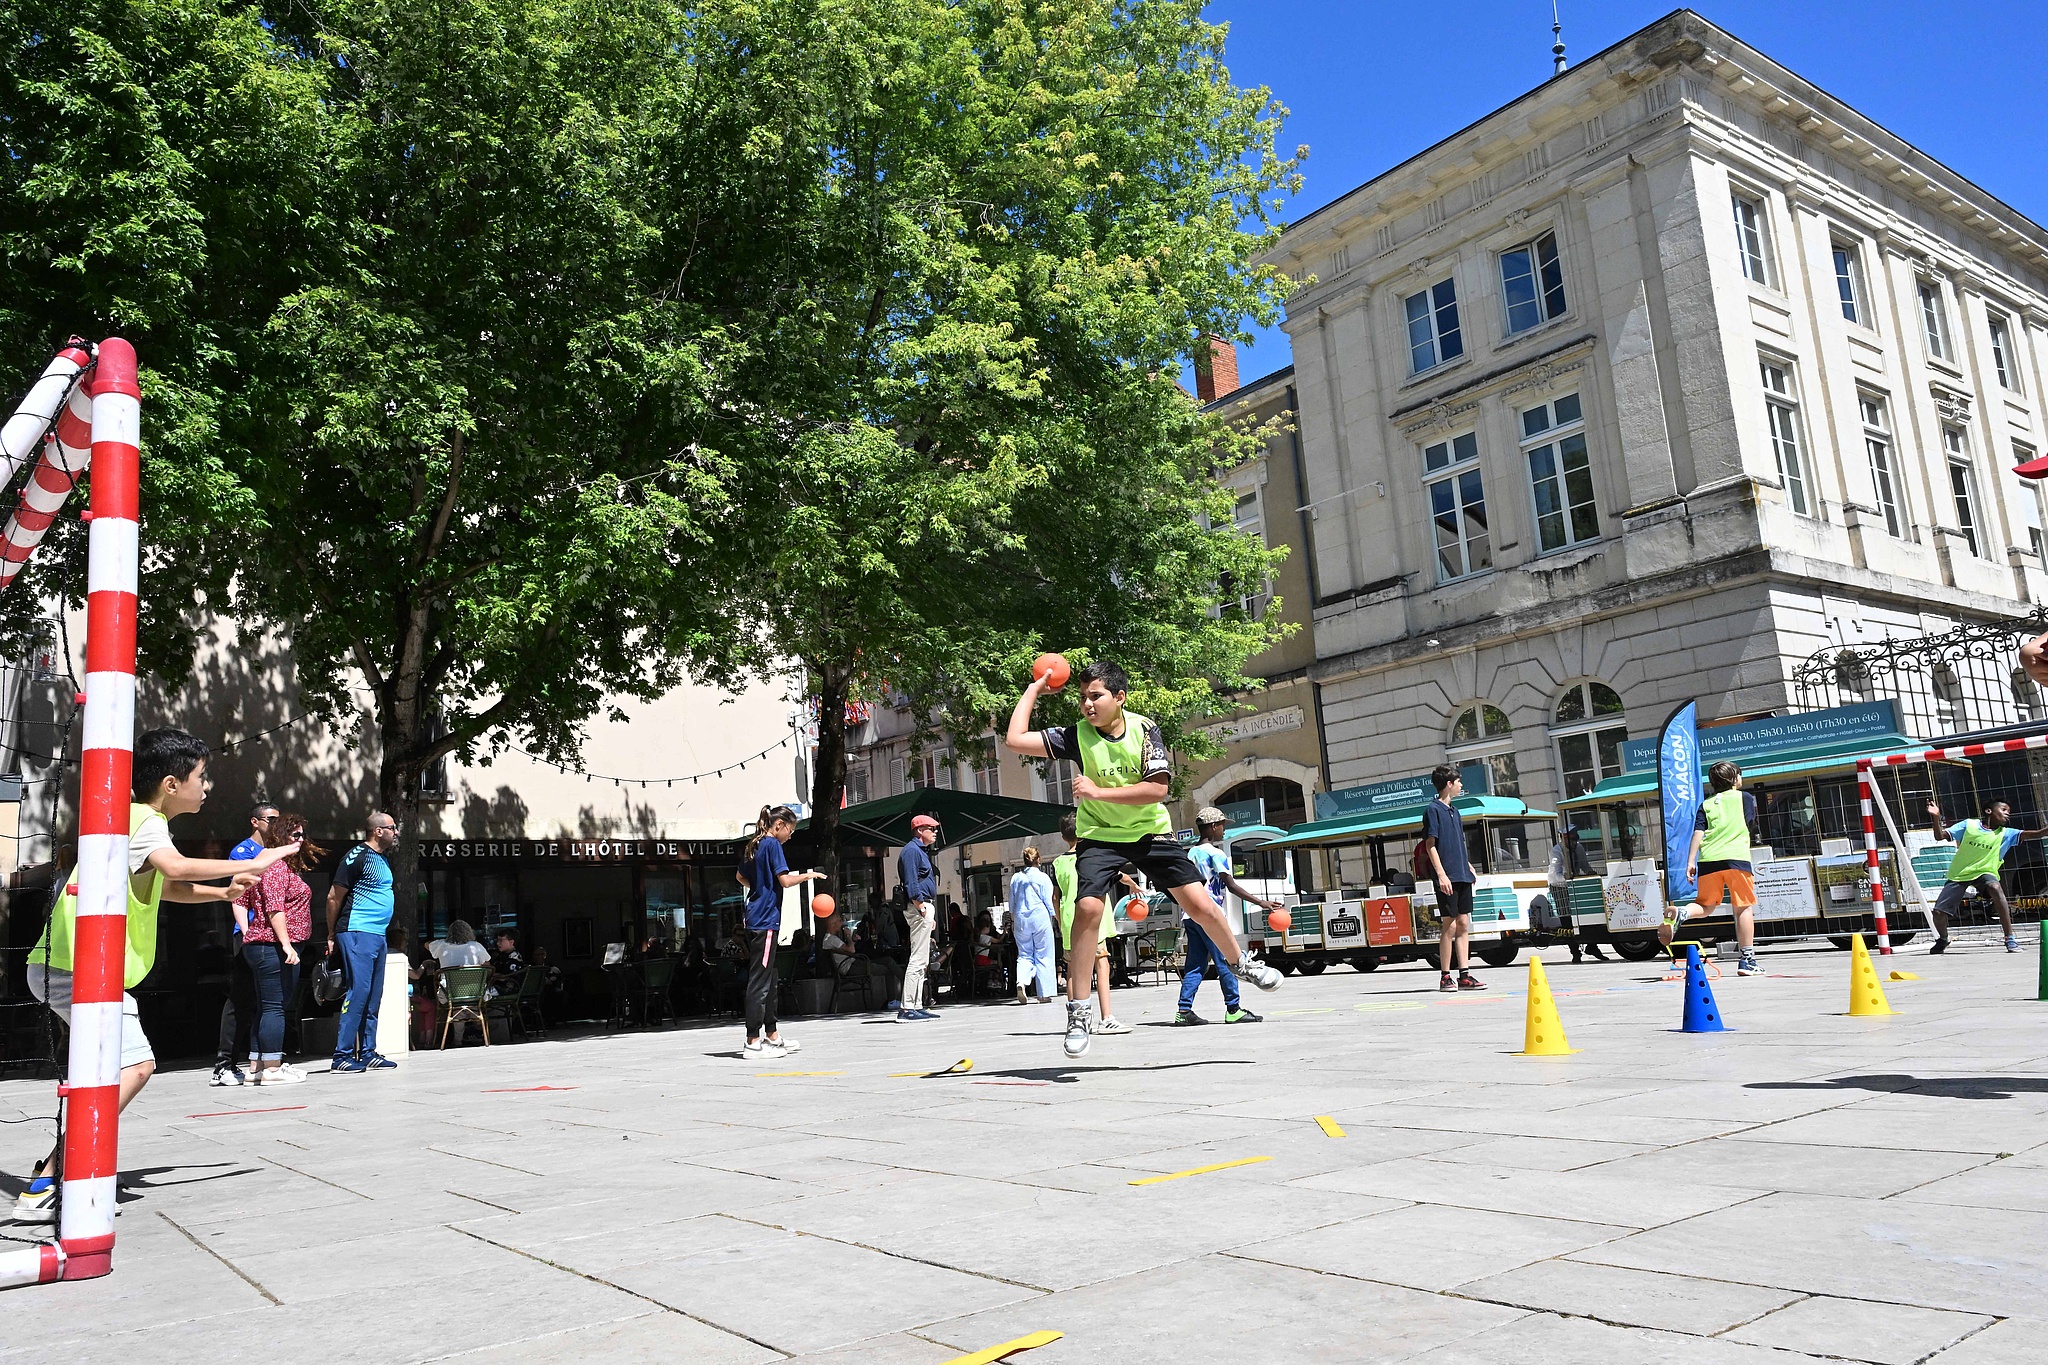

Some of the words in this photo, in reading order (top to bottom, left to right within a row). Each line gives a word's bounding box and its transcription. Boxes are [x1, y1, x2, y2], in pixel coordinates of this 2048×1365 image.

[1251, 713, 1295, 732] INCENDIE
[1633, 748, 1657, 758] Dépar
[1701, 736, 1726, 747] 11h30,
[1728, 731, 1755, 743] 14h30,
[1757, 727, 1786, 738] 15h30,
[1786, 722, 1814, 734] 16h30
[1815, 717, 1847, 730] (17h30
[1848, 717, 1860, 725] en
[1862, 711, 1880, 722] été)
[1728, 745, 1753, 753] Bourgogne
[1770, 737, 1804, 746] Saint-Vincent
[1807, 732, 1836, 740] Cathédrale
[1840, 727, 1867, 736] Hôtel-Dieu
[1344, 787, 1381, 800] Réservation
[1387, 781, 1411, 792] l'Office
[1411, 779, 1421, 789] de
[1235, 810, 1251, 819] Train
[1337, 808, 1357, 816] Découvrez
[1371, 803, 1392, 811] autrement
[419, 843, 522, 858] RASSERIE
[534, 843, 559, 857] DE
[571, 840, 645, 857] L'HÔTEL
[656, 842, 678, 856] DE
[688, 842, 735, 856] VILLE
[1619, 916, 1656, 926] JUMPING
